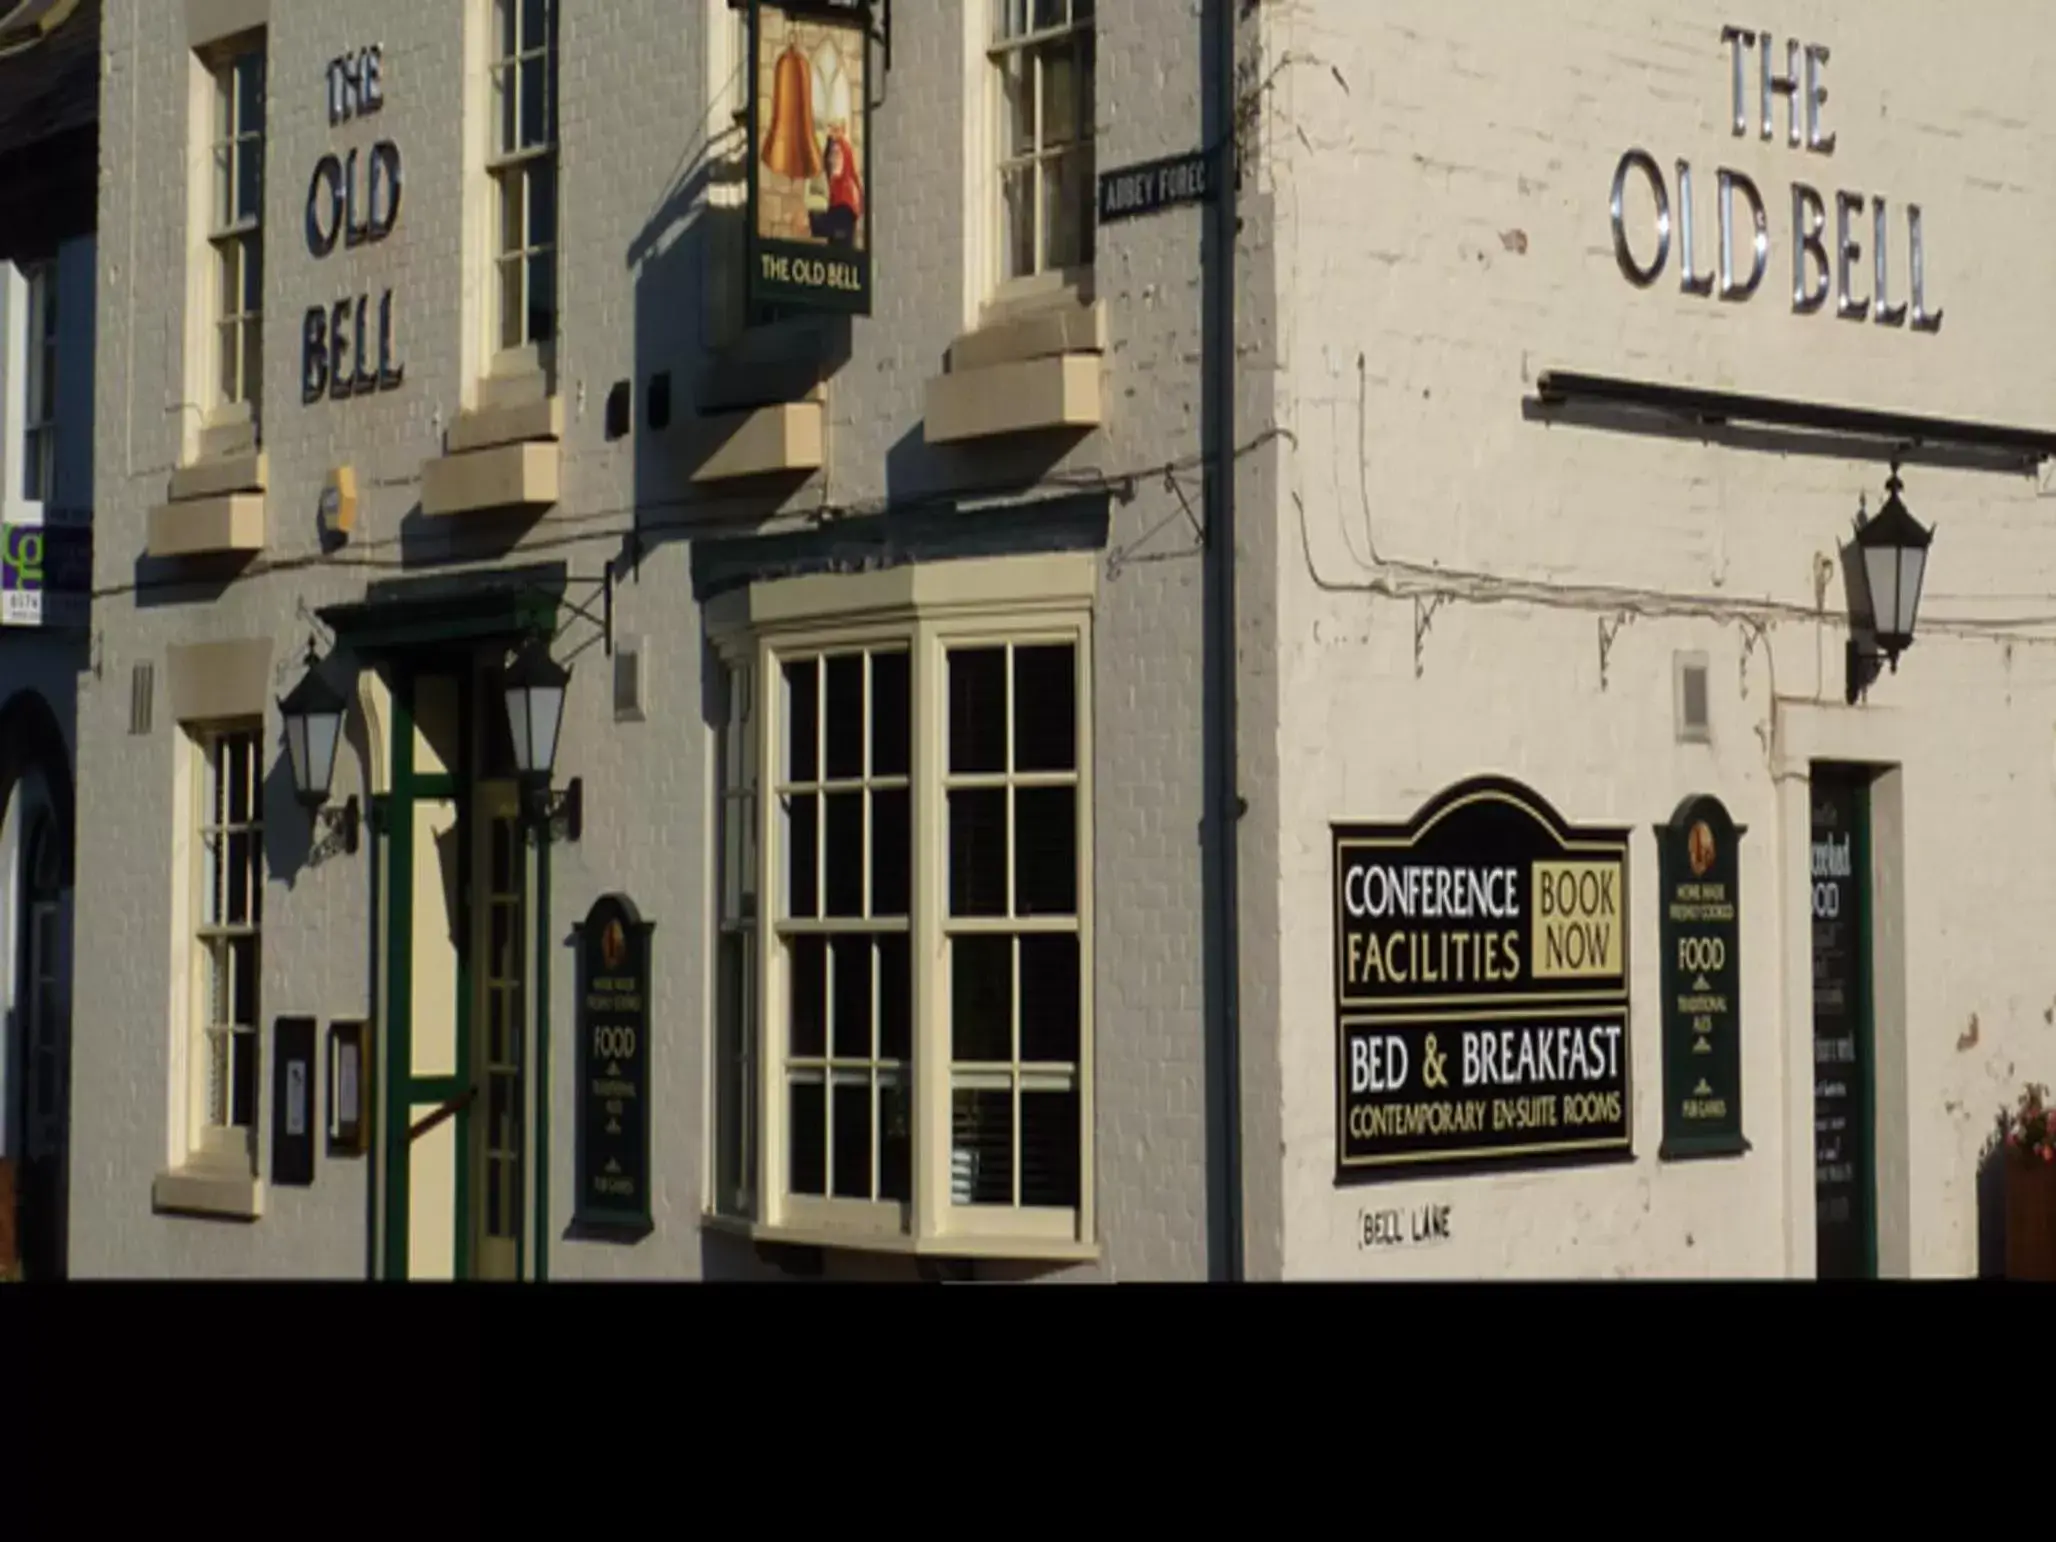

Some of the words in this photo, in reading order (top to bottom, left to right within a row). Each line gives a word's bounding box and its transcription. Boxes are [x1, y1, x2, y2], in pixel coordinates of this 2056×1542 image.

[325, 45, 384, 128] THE
[1720, 24, 1836, 156] THE
[306, 140, 402, 259] OLD
[1105, 172, 1154, 213] ABBEY
[1609, 148, 1768, 303] OLD
[1791, 181, 1943, 335] BELL
[762, 253, 790, 281] THE
[791, 258, 826, 286] OLD
[827, 262, 861, 291] BELL
[302, 288, 404, 407] BELL
[1344, 864, 1520, 918] CONFERENCE
[1540, 868, 1616, 918] BOOK
[1348, 930, 1521, 983] FACILITIES
[1545, 921, 1611, 970] NOW
[1678, 937, 1725, 973] FOOD
[594, 1024, 636, 1059] FOOD
[1350, 1034, 1409, 1093] BED
[1422, 1033, 1448, 1088] &
[1462, 1024, 1621, 1087] BREAKFAST
[1350, 1101, 1486, 1140] CONTEMPORARY
[1493, 1094, 1557, 1132] EN-SUITE
[1563, 1091, 1621, 1126] ROOMS
[1364, 1209, 1404, 1246] BELL
[1411, 1203, 1451, 1242] LANE
